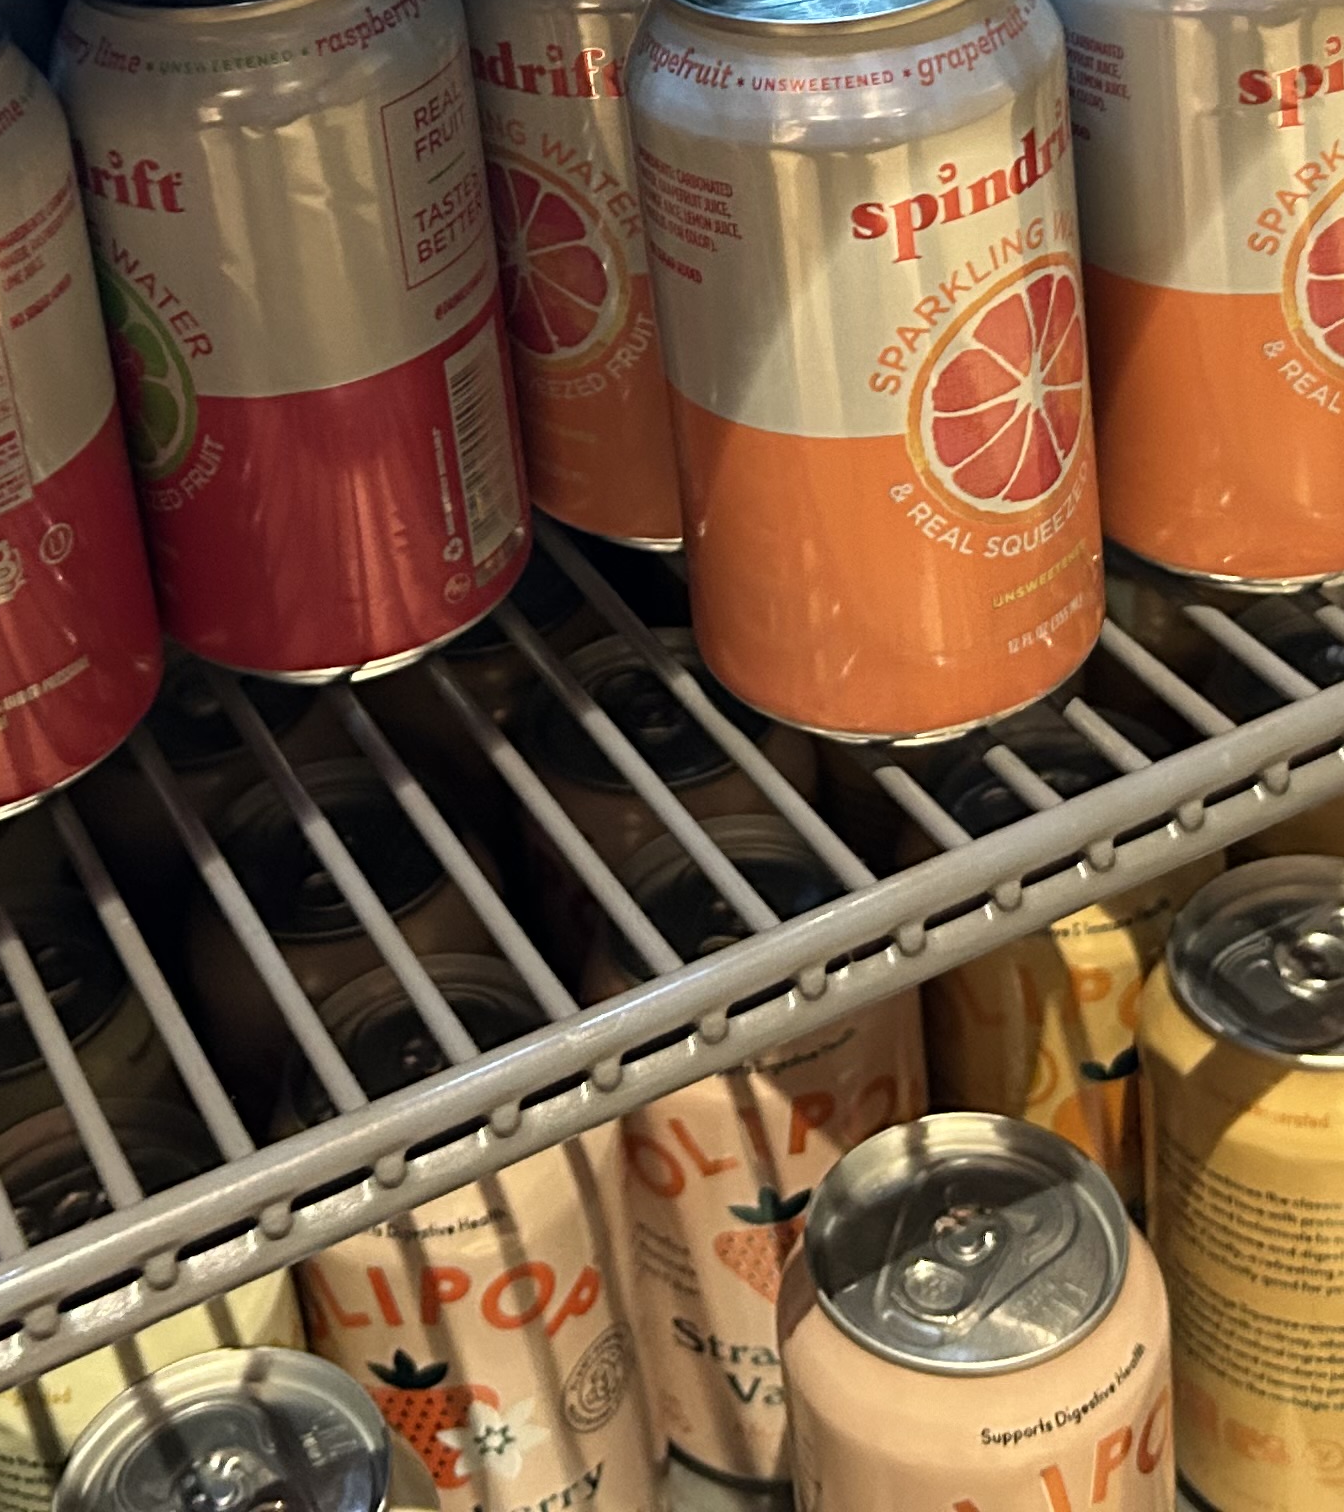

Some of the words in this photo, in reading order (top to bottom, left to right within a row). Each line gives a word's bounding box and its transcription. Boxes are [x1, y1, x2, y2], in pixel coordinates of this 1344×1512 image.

[93, 34, 143, 76] lime
[750, 68, 895, 94] UNSWEETENED
[915, 7, 1028, 86] grapefruit
[540, 133, 648, 238] WATER
[109, 238, 215, 361] WATER
[867, 215, 1045, 397] SPARKLING
[605, 312, 656, 380] FRUIT
[1261, 339, 1286, 361] &
[1277, 359, 1343, 416] REAL
[180, 434, 226, 499] FRUIT
[889, 481, 914, 504] &
[906, 498, 975, 555] REAL
[306, 1260, 602, 1339] LIPOP
[980, 1415, 1054, 1447] Supports
[1054, 1382, 1117, 1430] Digestive
[1114, 1342, 1147, 1386] Health
